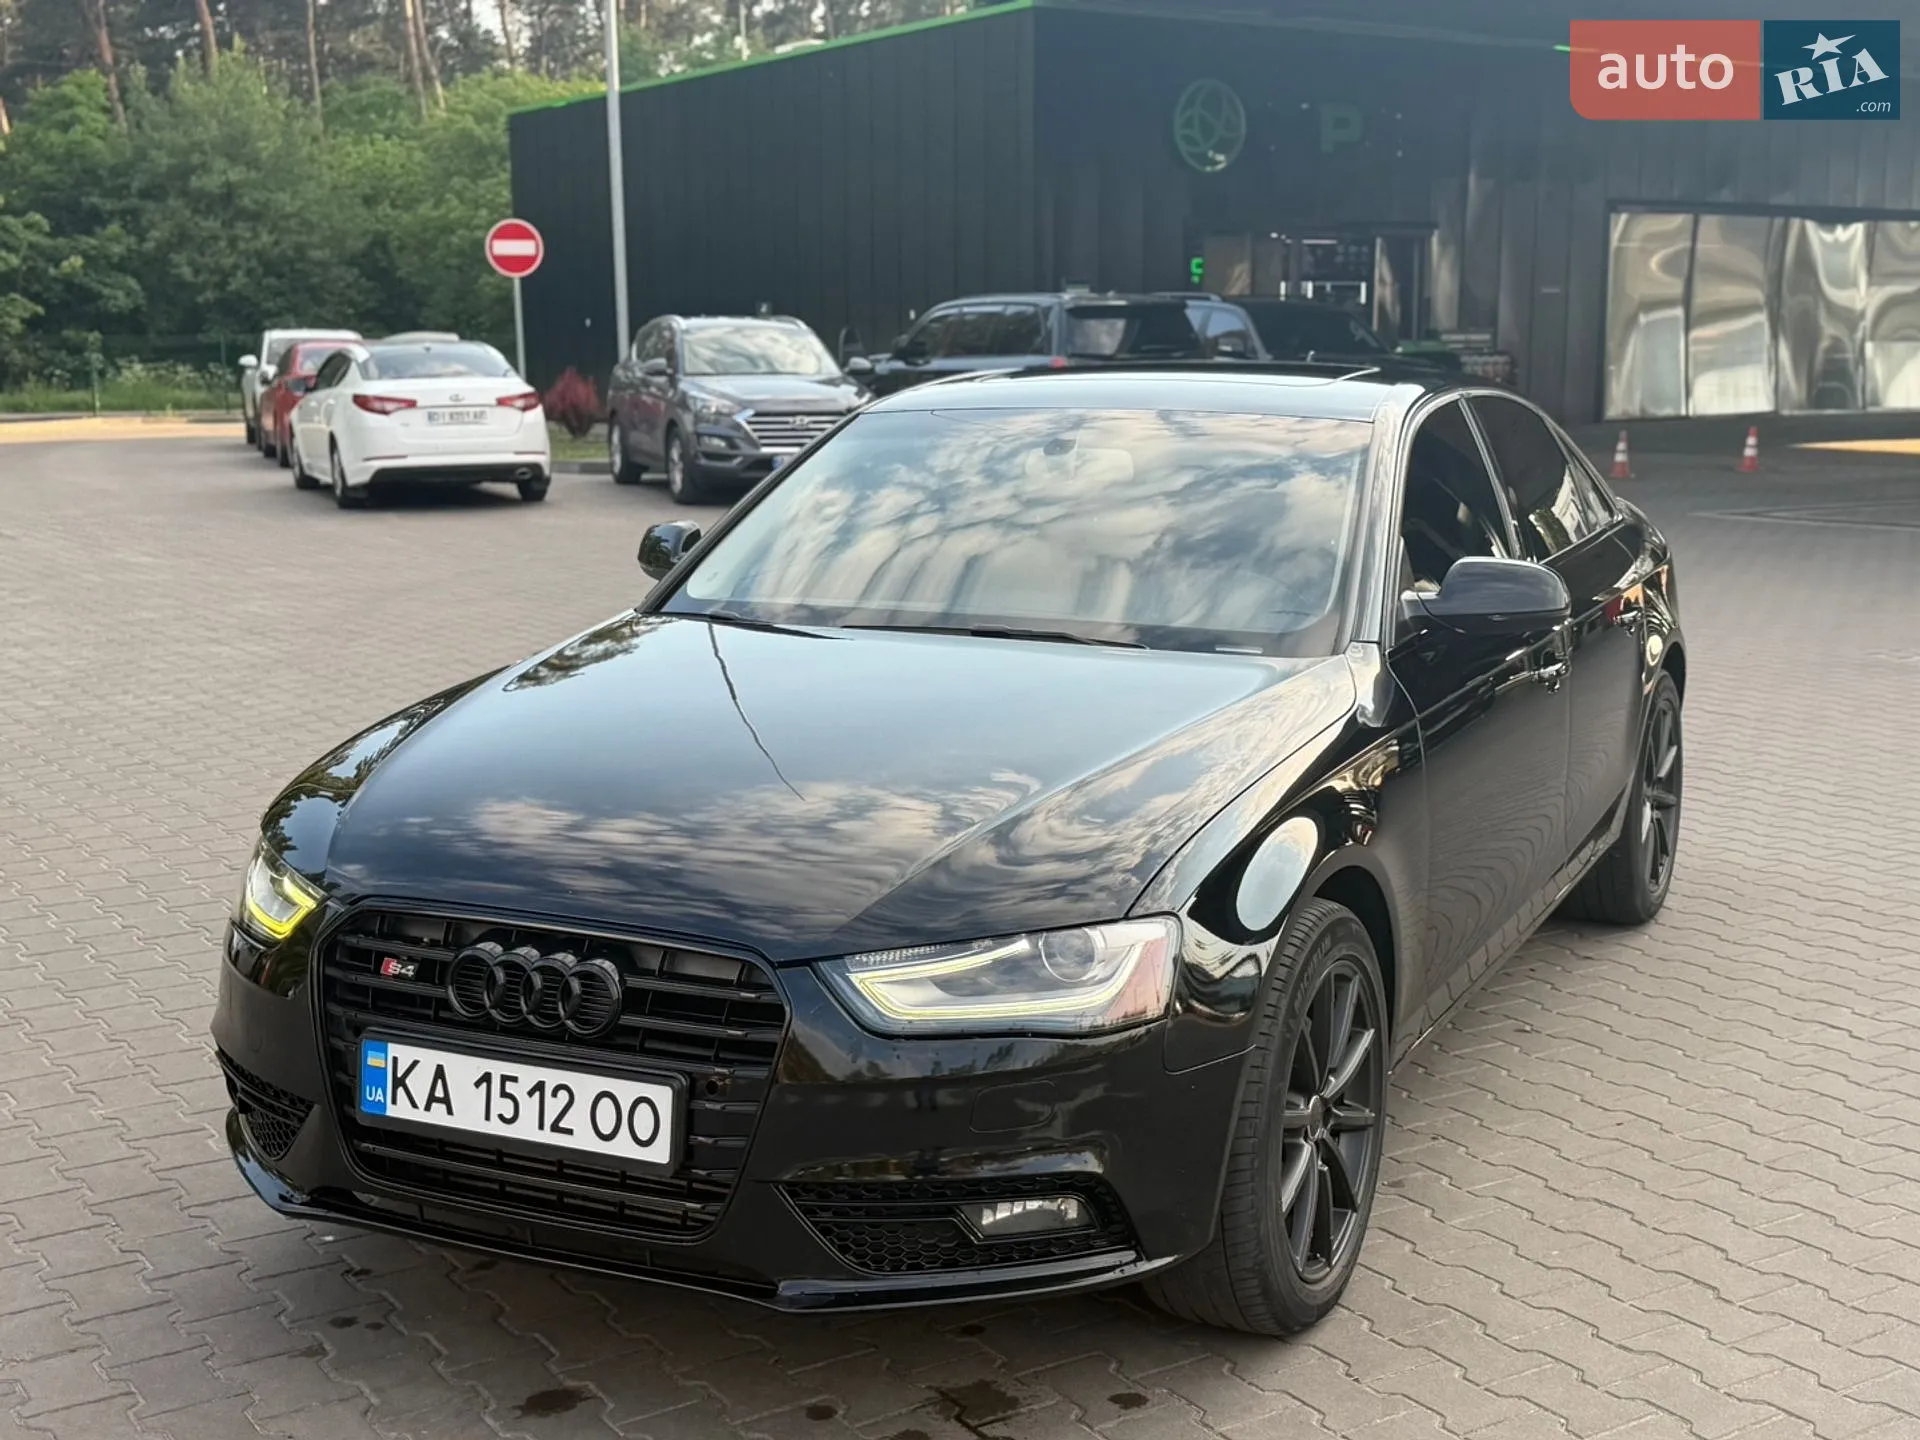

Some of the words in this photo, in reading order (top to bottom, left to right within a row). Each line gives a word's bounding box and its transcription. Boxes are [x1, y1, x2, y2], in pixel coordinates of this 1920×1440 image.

[386, 960, 415, 977] S4
[366, 1085, 384, 1103] UA
[391, 1056, 454, 1116] KA
[473, 1071, 574, 1136] 1512
